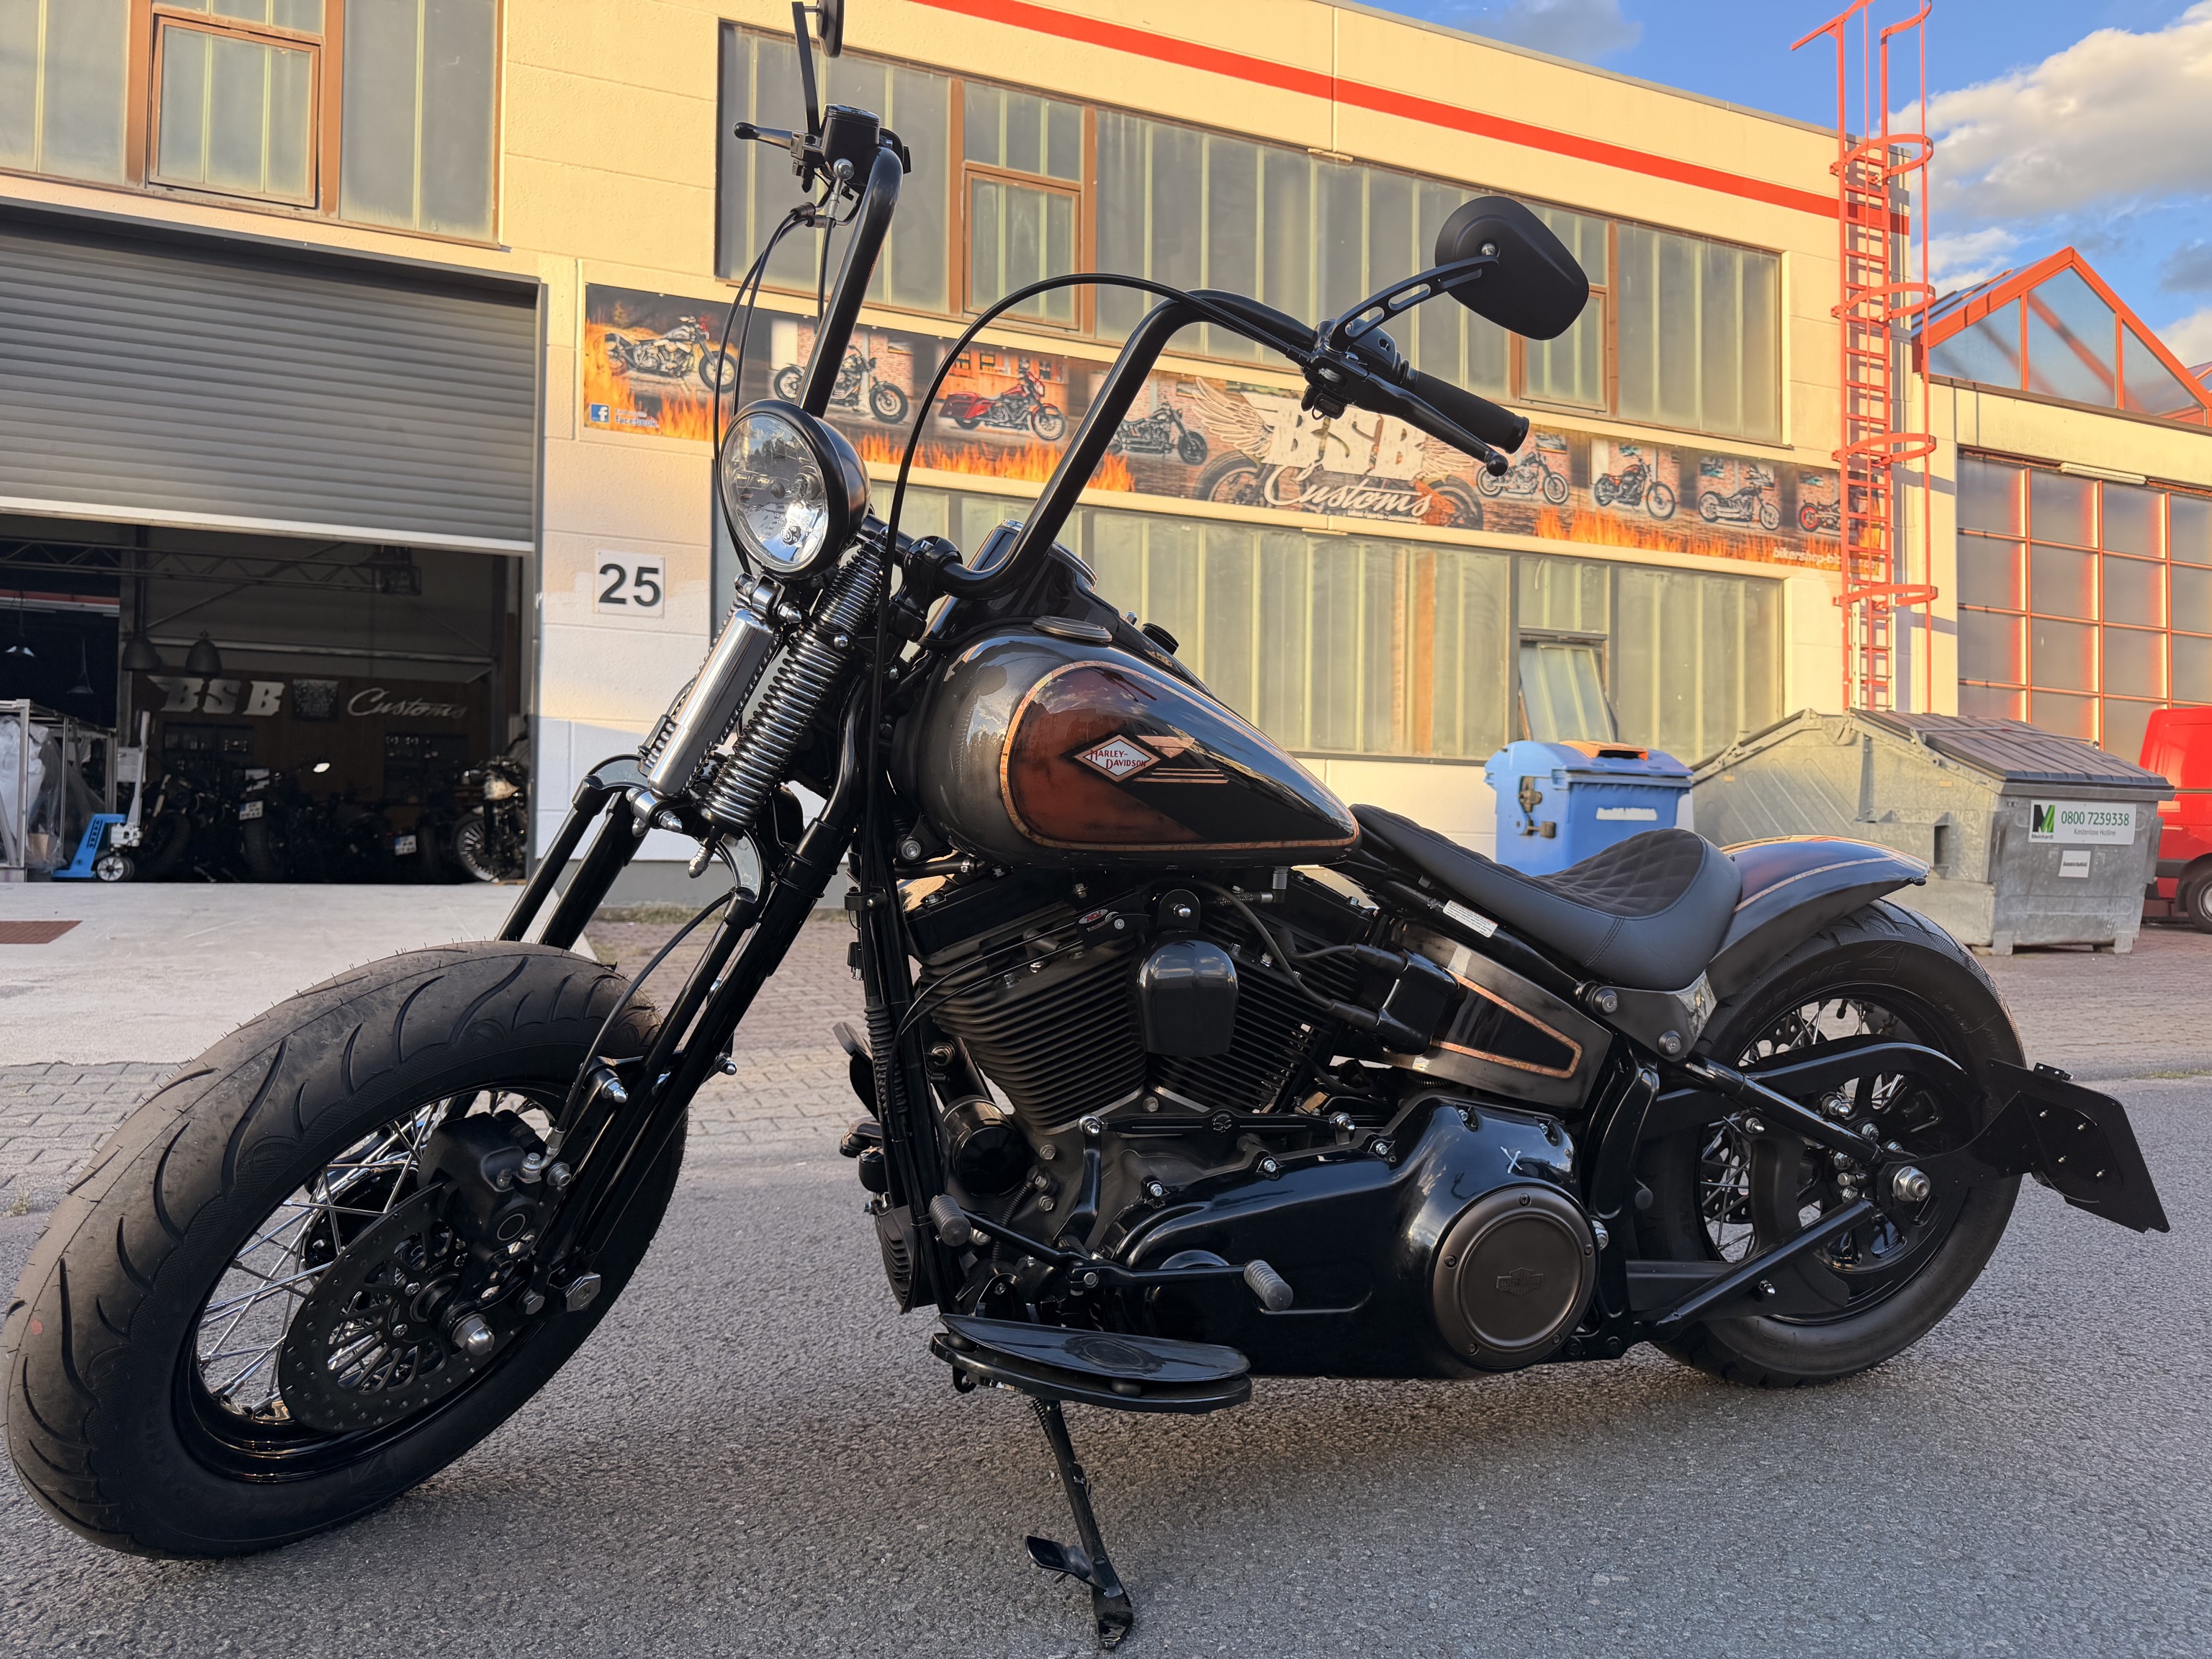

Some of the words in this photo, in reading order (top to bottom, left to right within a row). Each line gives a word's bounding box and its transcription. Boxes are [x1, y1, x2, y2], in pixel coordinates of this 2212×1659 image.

[1240, 392, 1430, 481] BSB
[1264, 461, 1433, 517] Customs
[598, 563, 661, 607] 25
[147, 675, 286, 716] BSB
[347, 687, 467, 719] Customs
[1090, 750, 1128, 761] HARLEY-
[1106, 759, 1146, 770] DAVIDSON
[2061, 811, 2085, 825] 0800
[2087, 811, 2130, 827] 7239338
